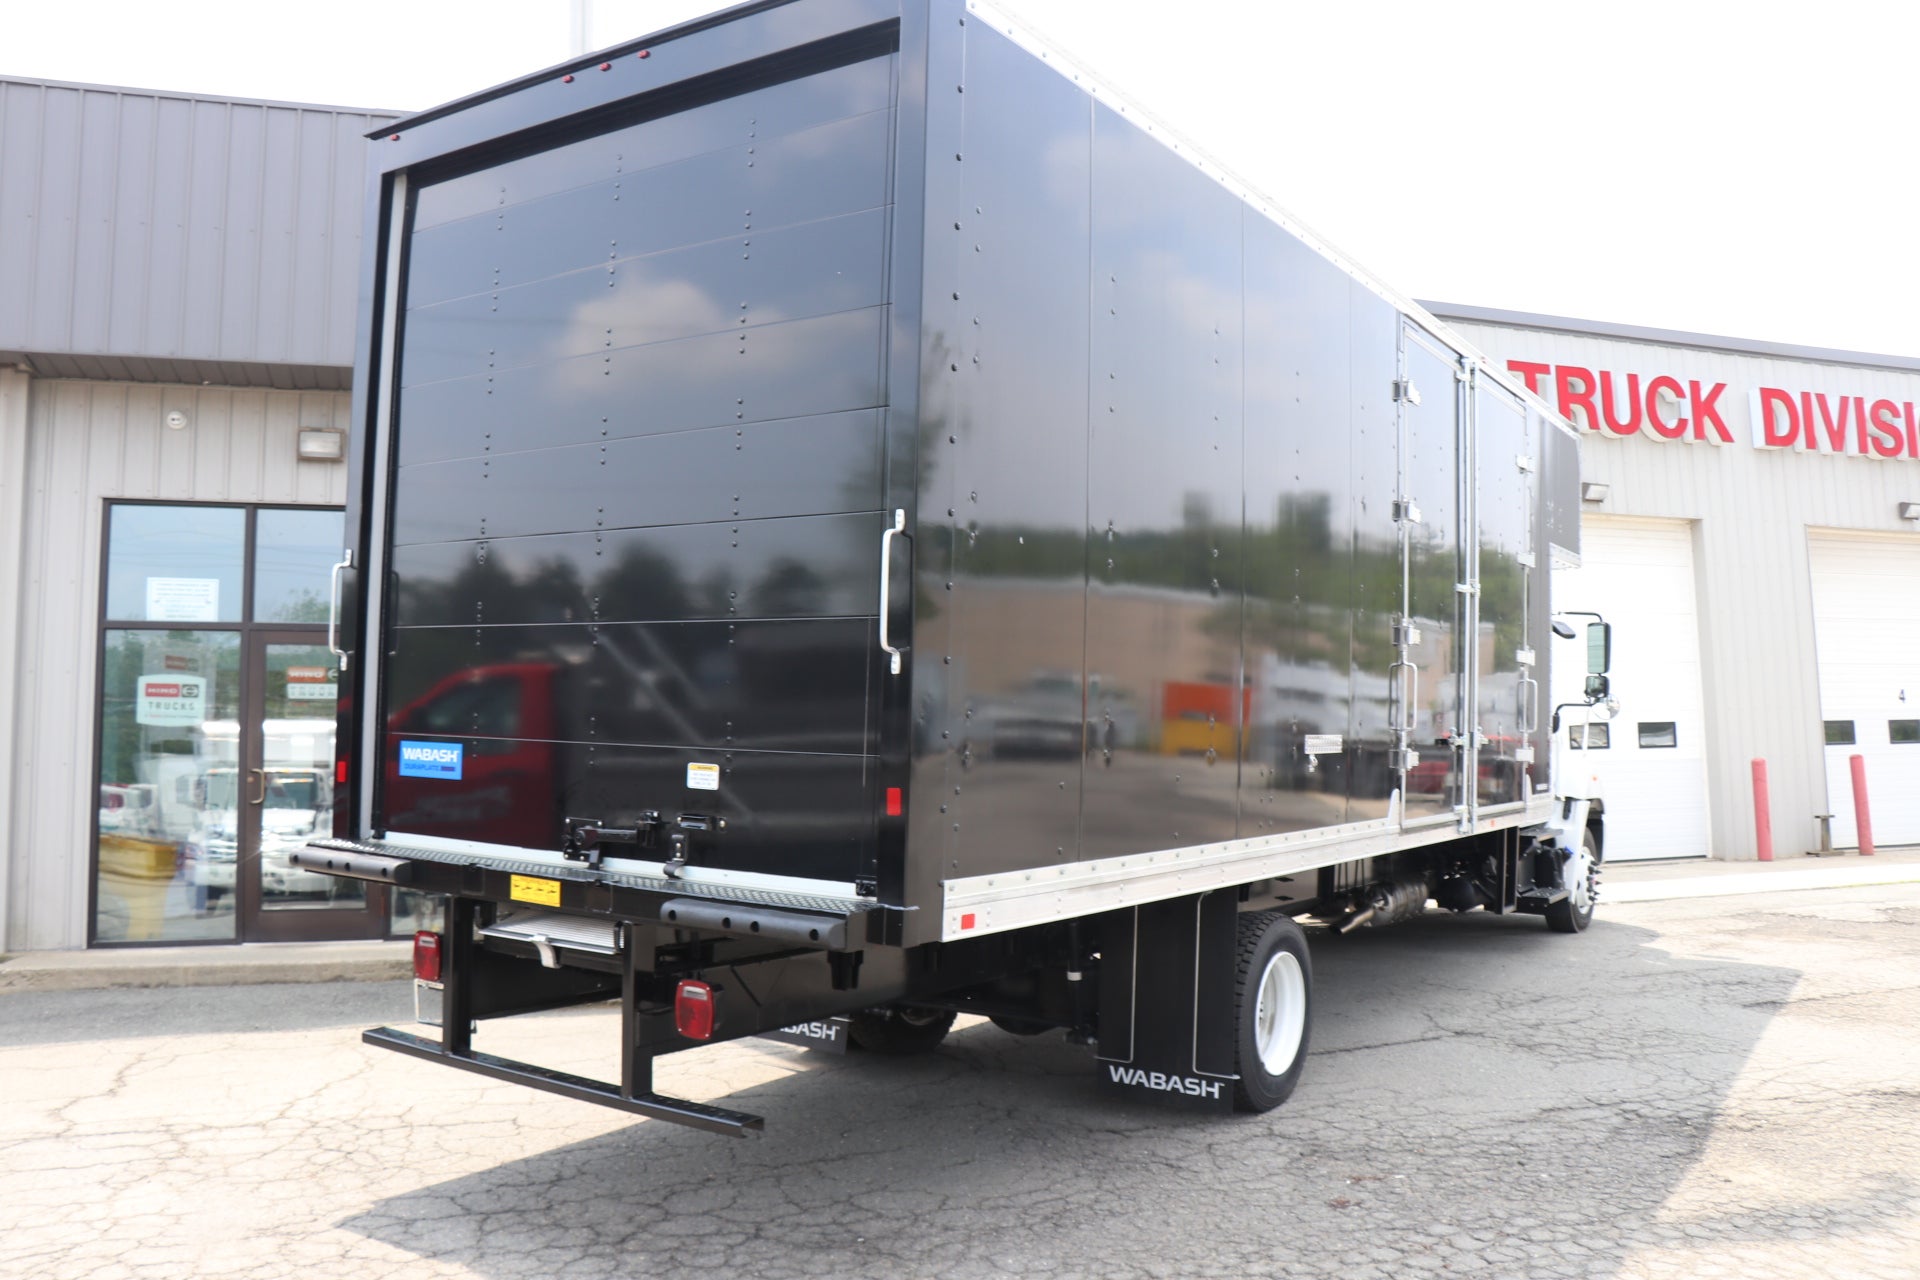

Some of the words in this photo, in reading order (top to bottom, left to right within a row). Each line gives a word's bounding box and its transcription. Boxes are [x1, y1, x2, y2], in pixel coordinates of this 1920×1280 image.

[1507, 359, 1735, 443] TRUCK
[1759, 387, 1919, 458] DIVISI
[148, 702, 195, 710] TRUCKS
[402, 747, 458, 762] WABASH
[1109, 1065, 1220, 1099] WABASH
